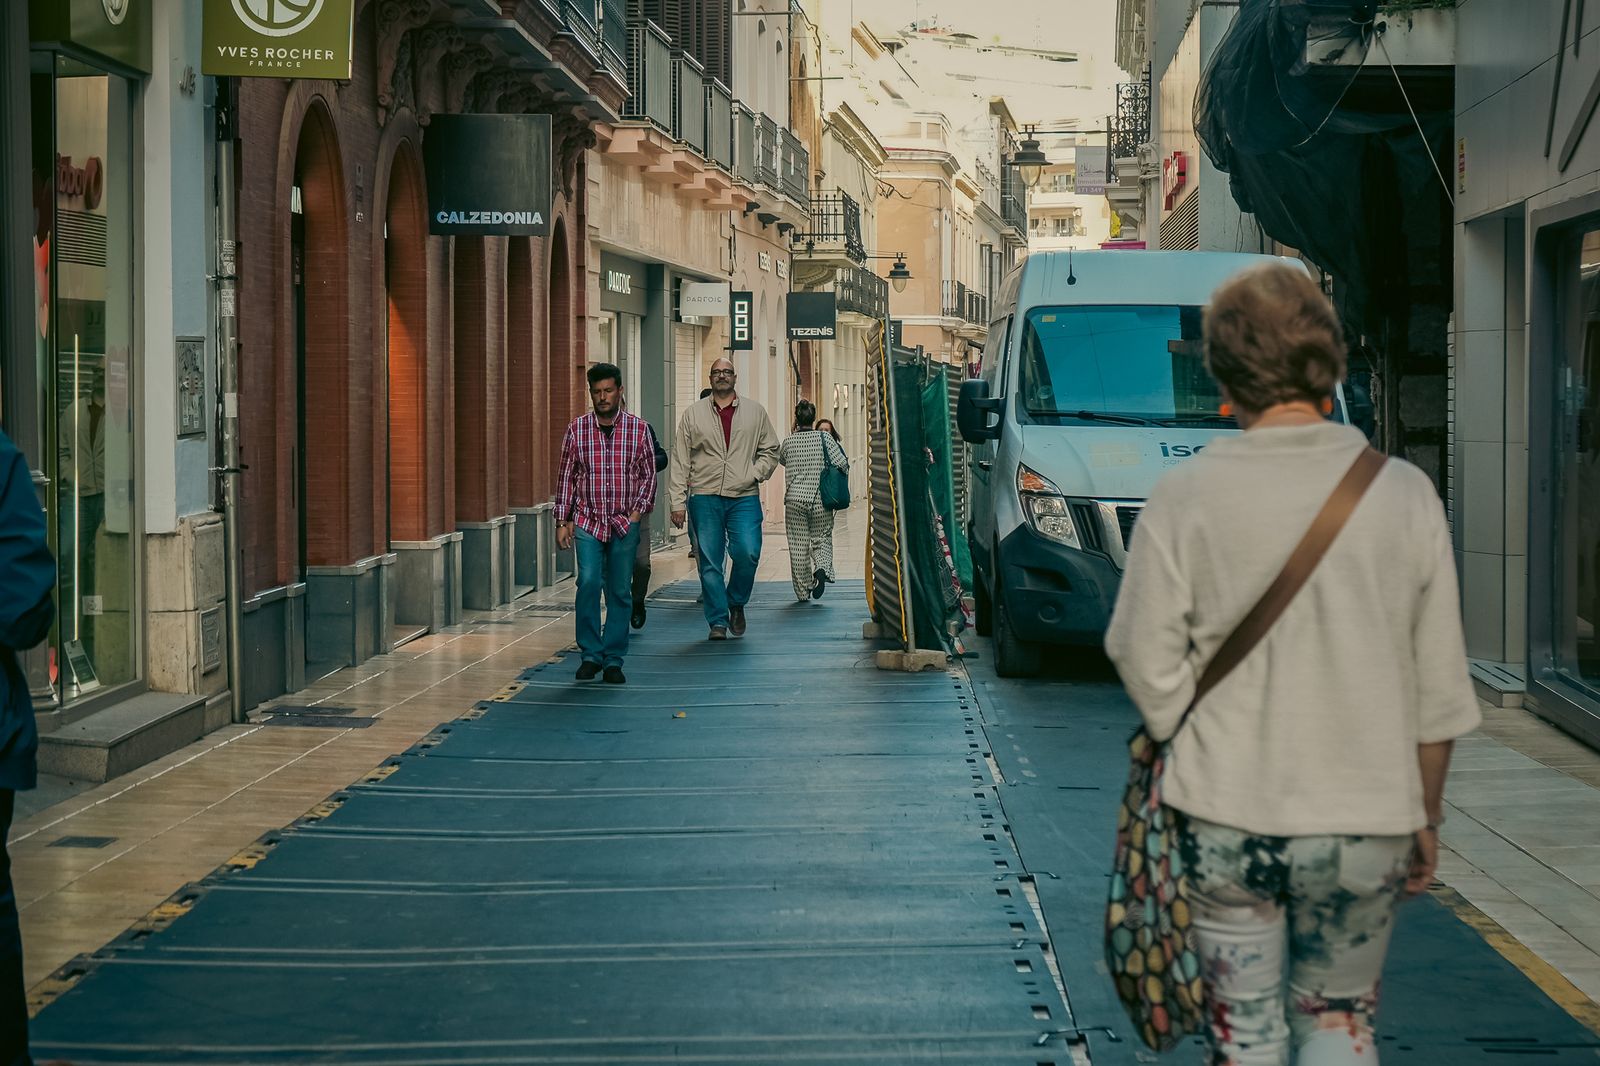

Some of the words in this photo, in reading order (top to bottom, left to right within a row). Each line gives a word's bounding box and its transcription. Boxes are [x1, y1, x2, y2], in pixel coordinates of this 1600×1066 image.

[217, 46, 259, 58] YVES
[265, 48, 334, 60] ROCHER
[249, 60, 301, 68] FRANCE
[436, 211, 544, 225] CALZEDONIA
[790, 326, 834, 336] TEZENIS
